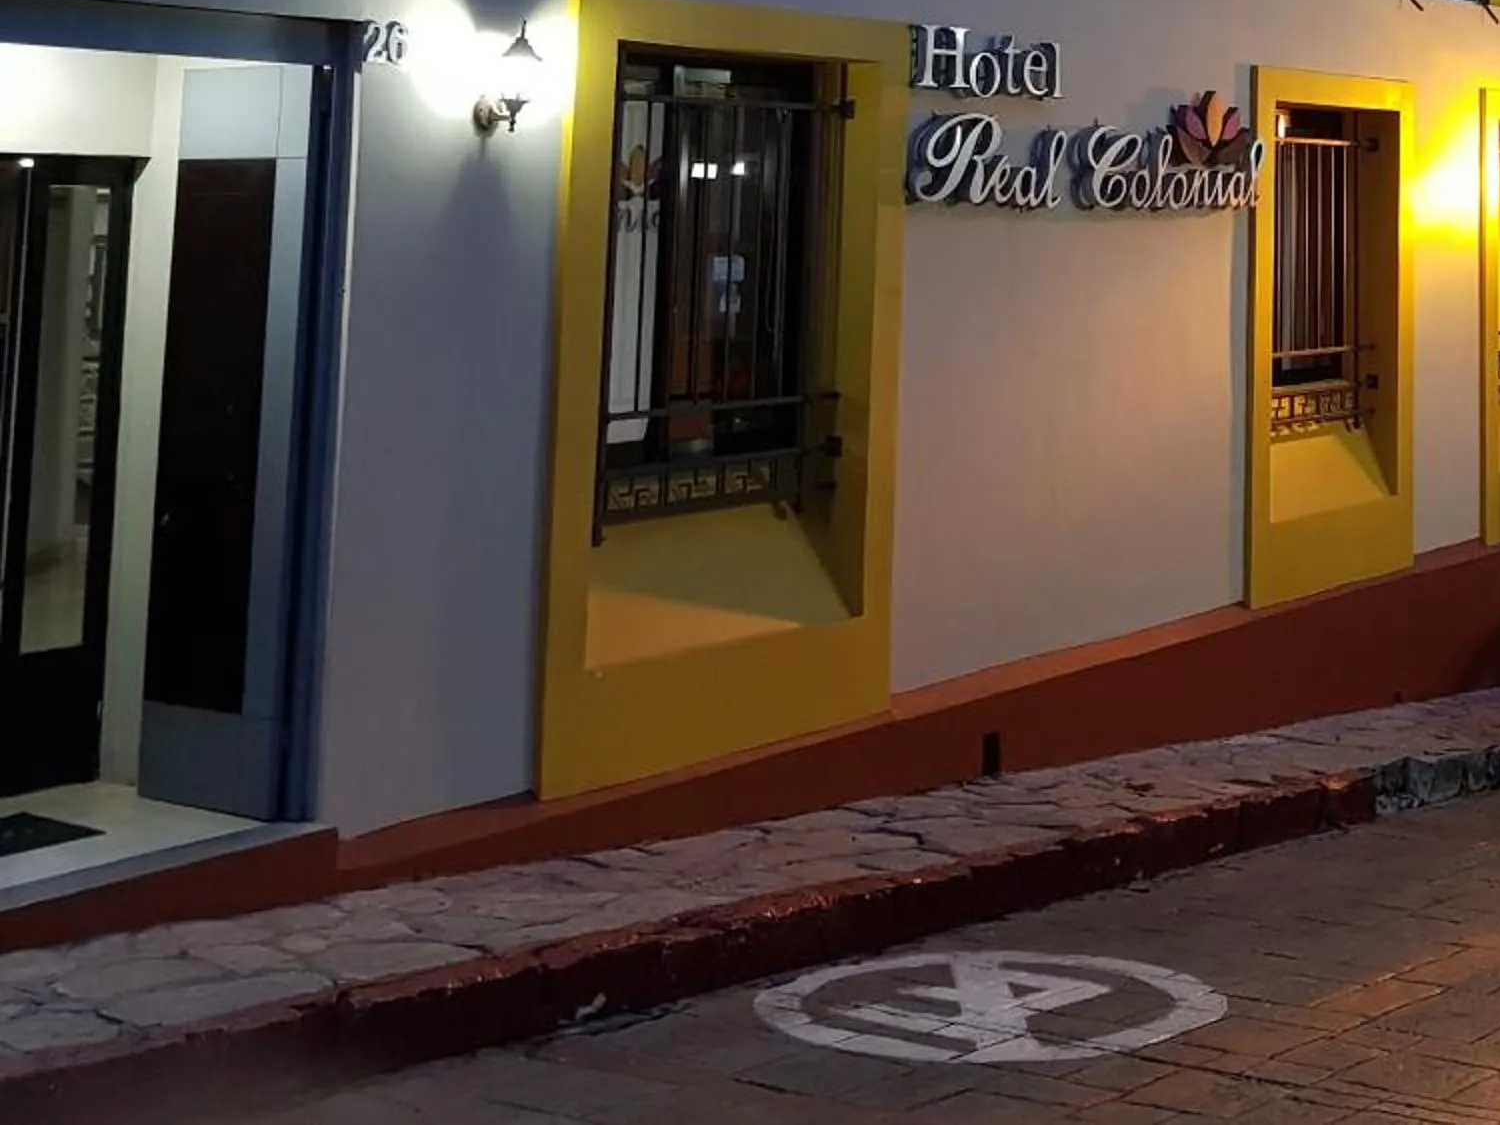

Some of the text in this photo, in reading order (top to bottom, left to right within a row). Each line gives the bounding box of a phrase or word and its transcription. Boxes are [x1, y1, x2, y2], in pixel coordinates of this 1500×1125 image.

[362, 19, 407, 63] 26
[914, 24, 1064, 99] Hotel
[916, 113, 1264, 210] Real Colonial
